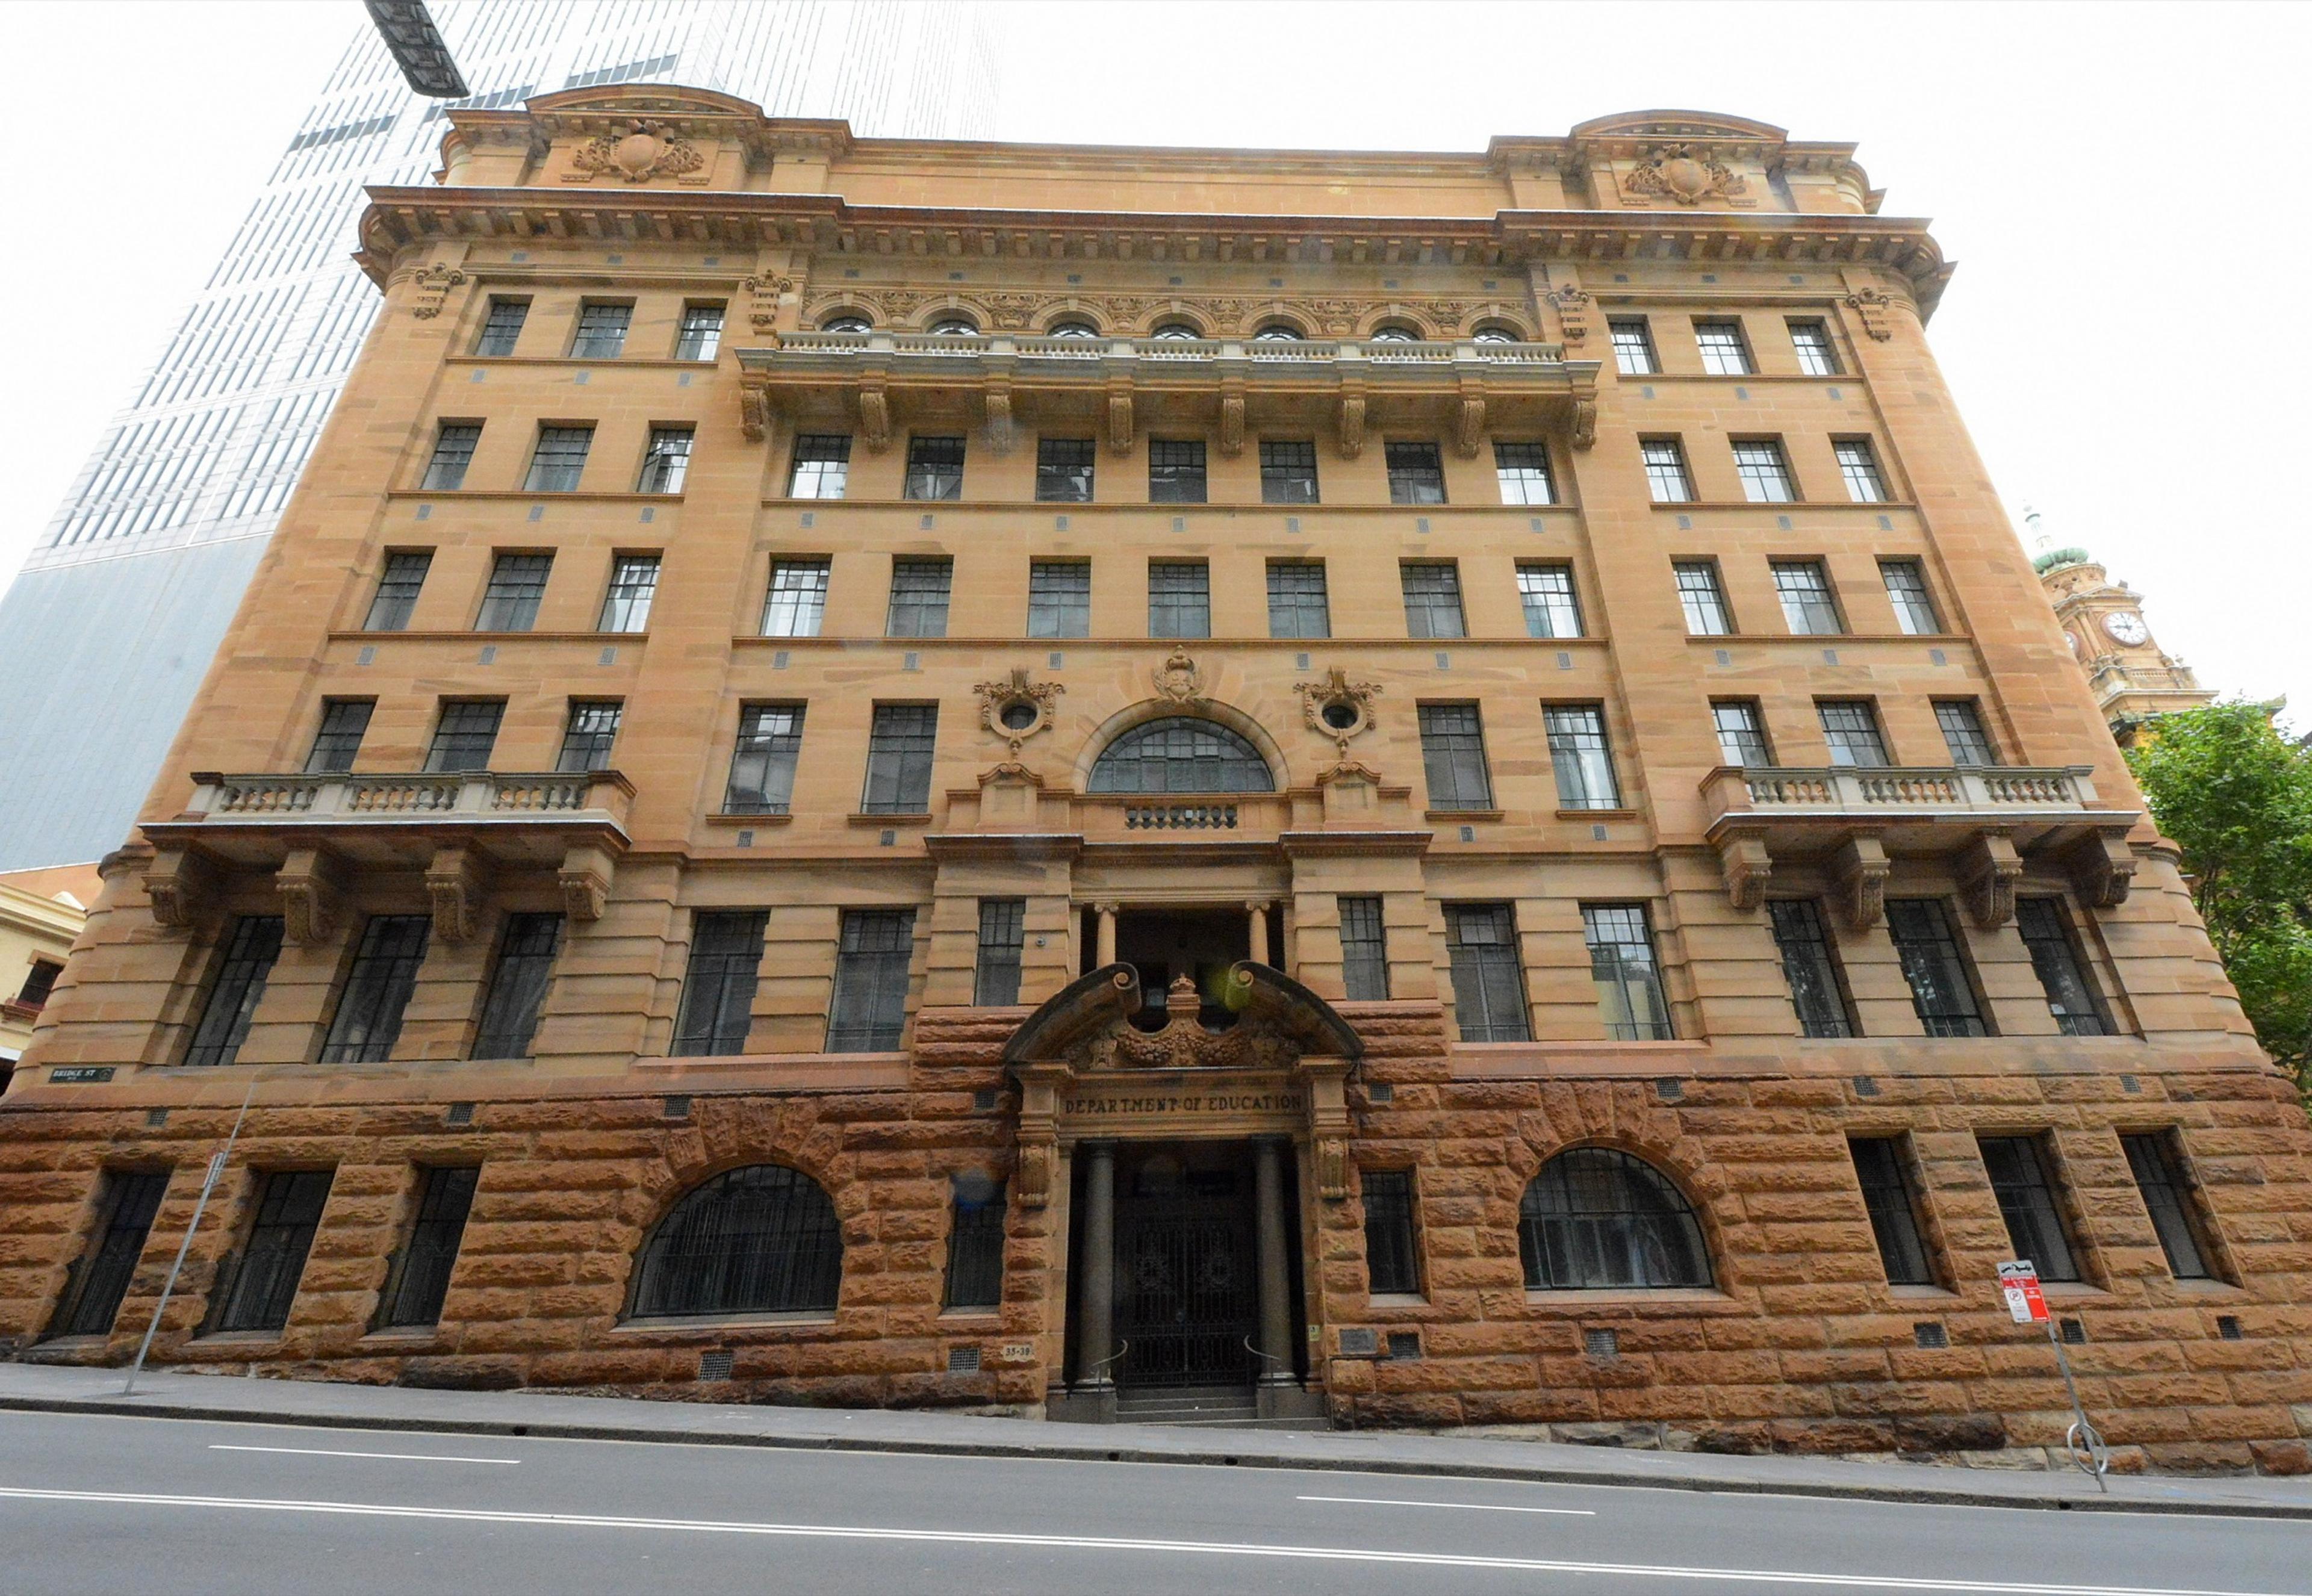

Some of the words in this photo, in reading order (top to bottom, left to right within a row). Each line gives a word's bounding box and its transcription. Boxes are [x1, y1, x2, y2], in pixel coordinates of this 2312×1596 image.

[1065, 1098, 1177, 1113] DEPARTMENT
[1183, 1096, 1201, 1111] OF
[1208, 1095, 1301, 1111] EDUCATION
[1005, 1347, 1030, 1356] 35-39
